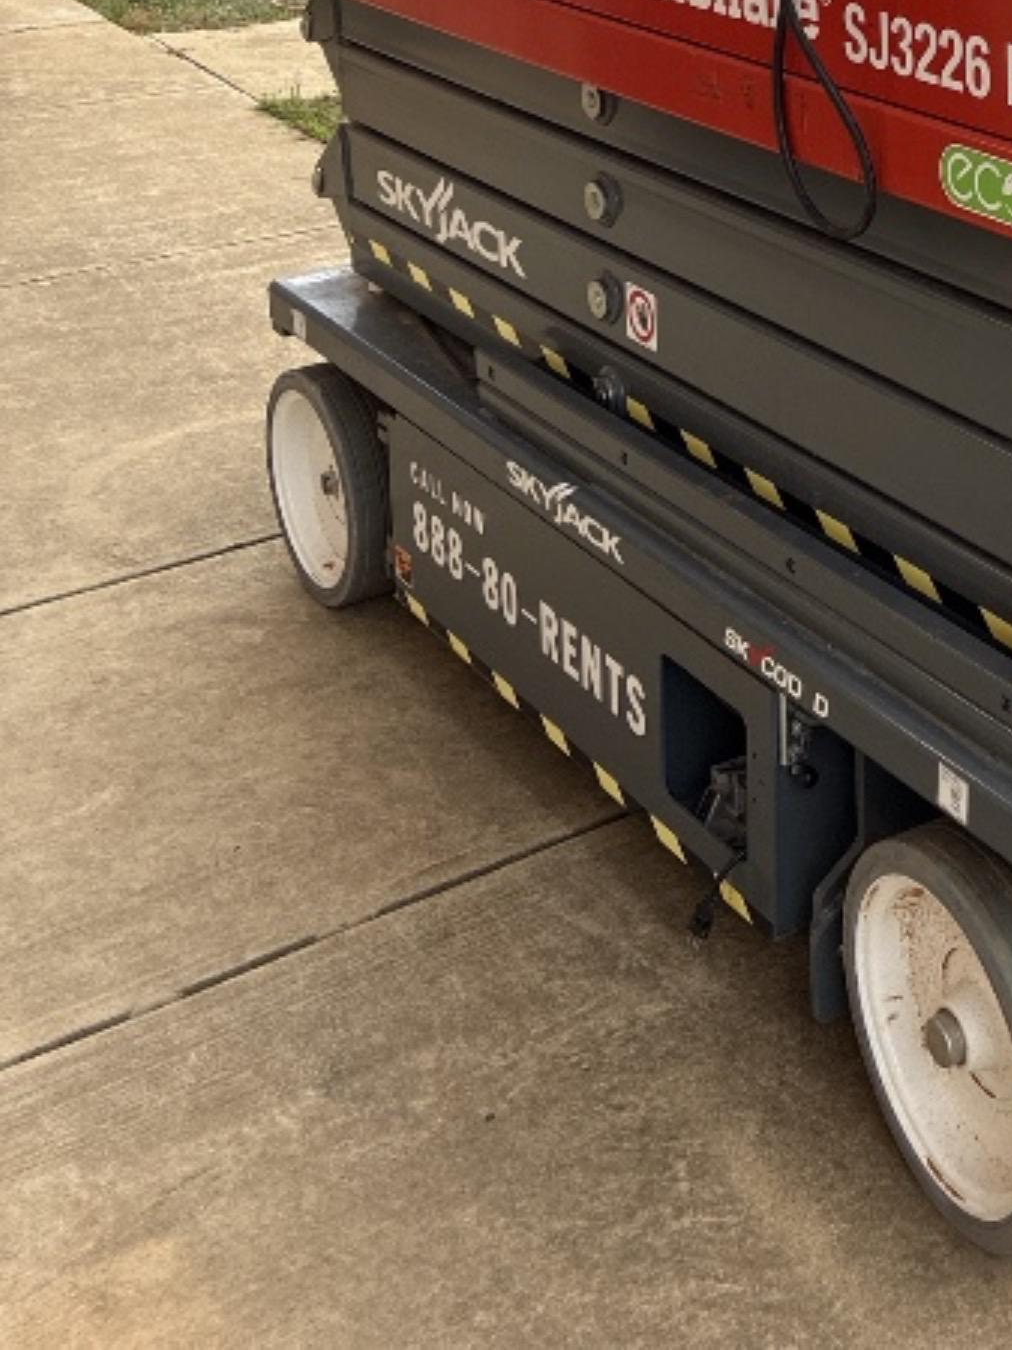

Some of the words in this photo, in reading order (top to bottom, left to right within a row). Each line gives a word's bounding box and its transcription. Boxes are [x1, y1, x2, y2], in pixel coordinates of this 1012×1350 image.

[842, 1, 993, 100] SJ3226
[376, 169, 527, 280] SKYJACK
[505, 460, 625, 565] SKYJACK
[412, 499, 647, 738] 888-80-RENTS
